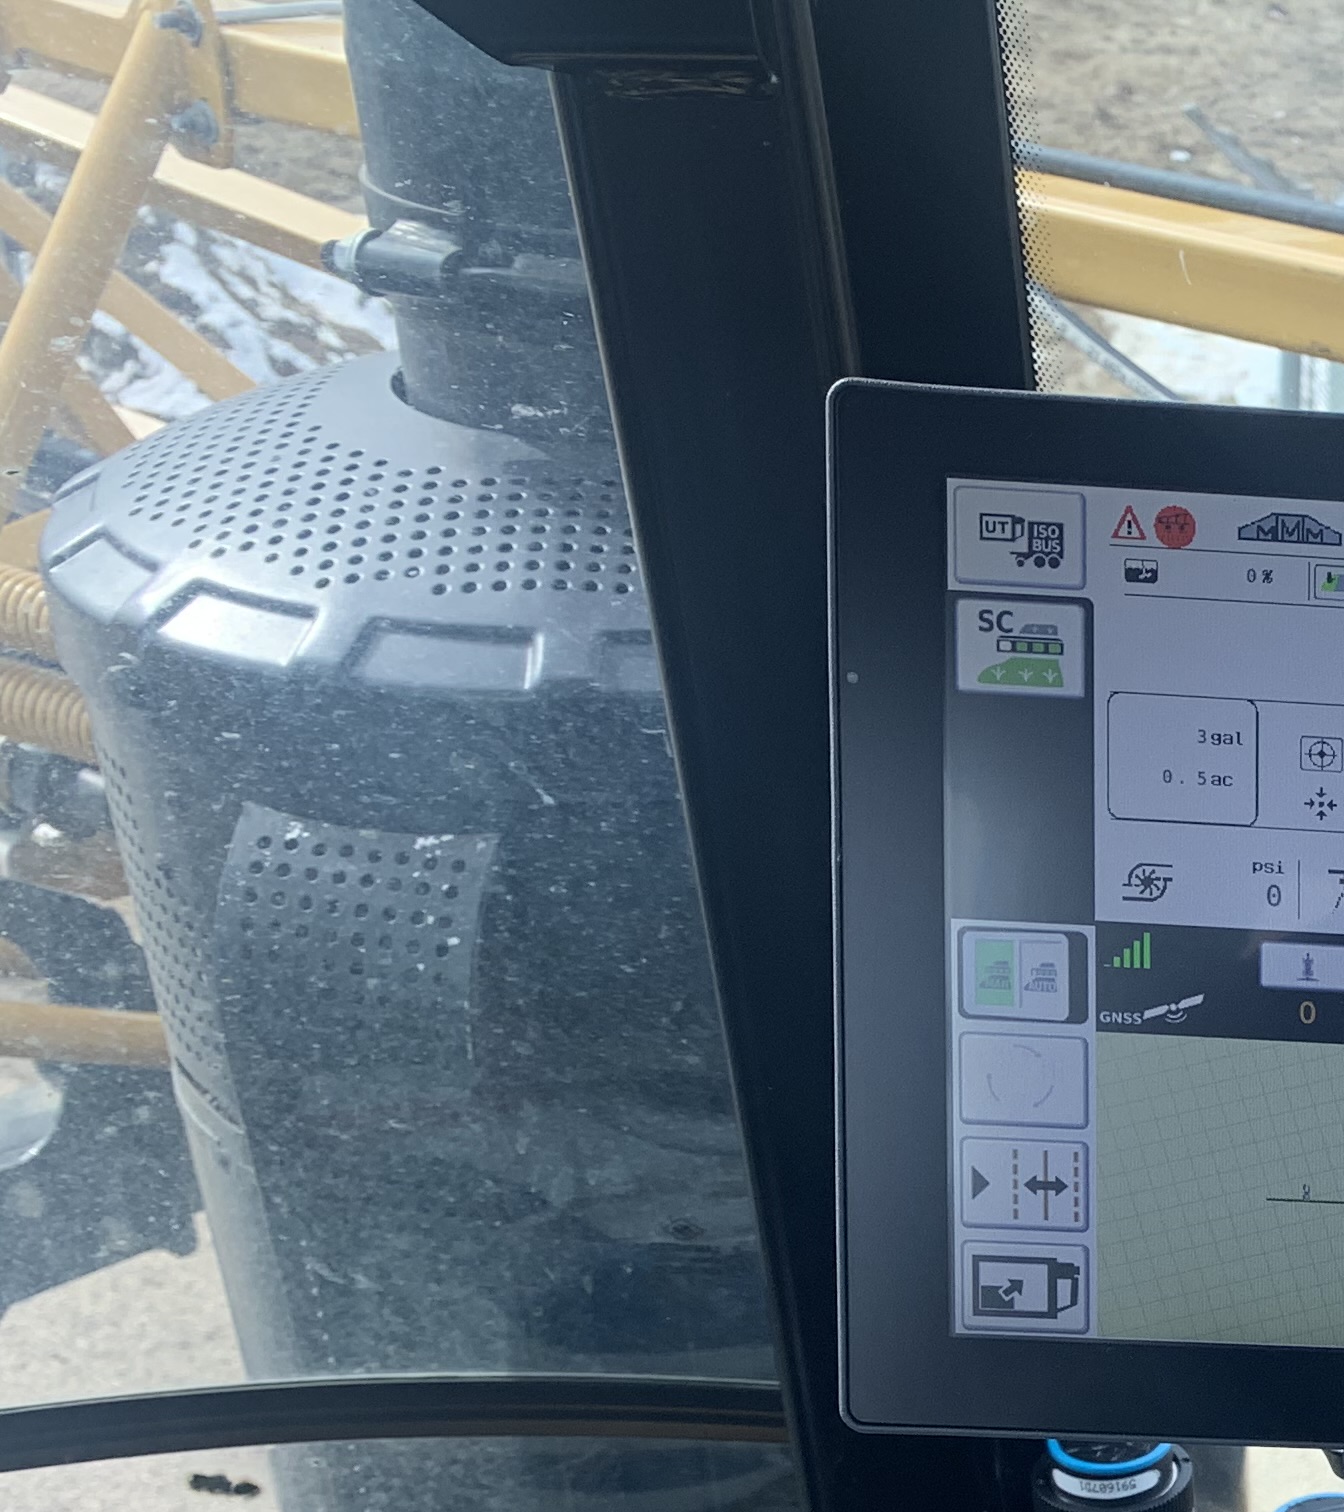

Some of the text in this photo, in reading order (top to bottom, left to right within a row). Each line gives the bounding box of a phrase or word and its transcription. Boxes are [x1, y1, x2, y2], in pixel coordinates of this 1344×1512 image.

[983, 519, 1008, 536] UT
[1032, 523, 1059, 539] ISO
[1031, 539, 1062, 554] BUS
[1246, 568, 1274, 585] 0%
[977, 609, 1014, 633] SC
[1251, 859, 1285, 877] psi
[1266, 884, 1283, 908] 0
[1099, 1010, 1142, 1026] GNSS
[1300, 1001, 1316, 1025] 0
